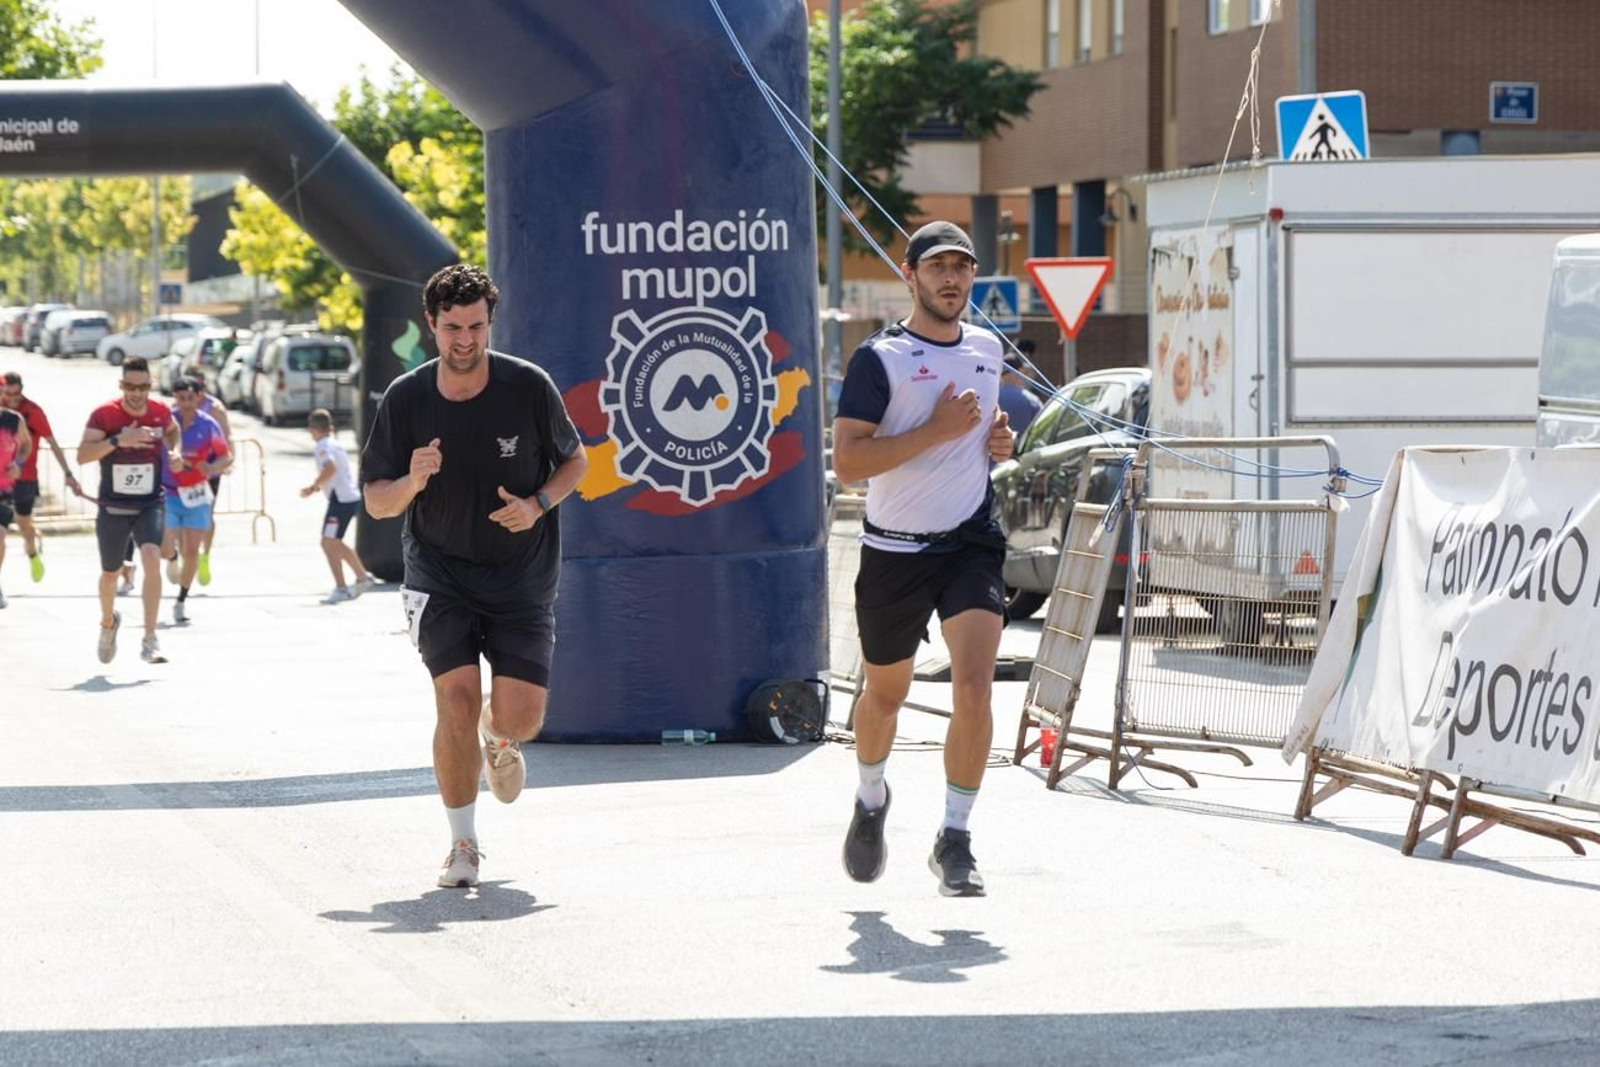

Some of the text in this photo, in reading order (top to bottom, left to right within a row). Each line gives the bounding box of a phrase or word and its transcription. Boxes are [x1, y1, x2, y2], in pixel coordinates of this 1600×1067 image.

[56, 117, 80, 134] de
[581, 208, 789, 255] fundación
[621, 254, 757, 307] mupol
[633, 332, 754, 408] Fundación de la Mutualidad de la
[664, 440, 729, 461] POLICÍA
[124, 474, 144, 487] 97
